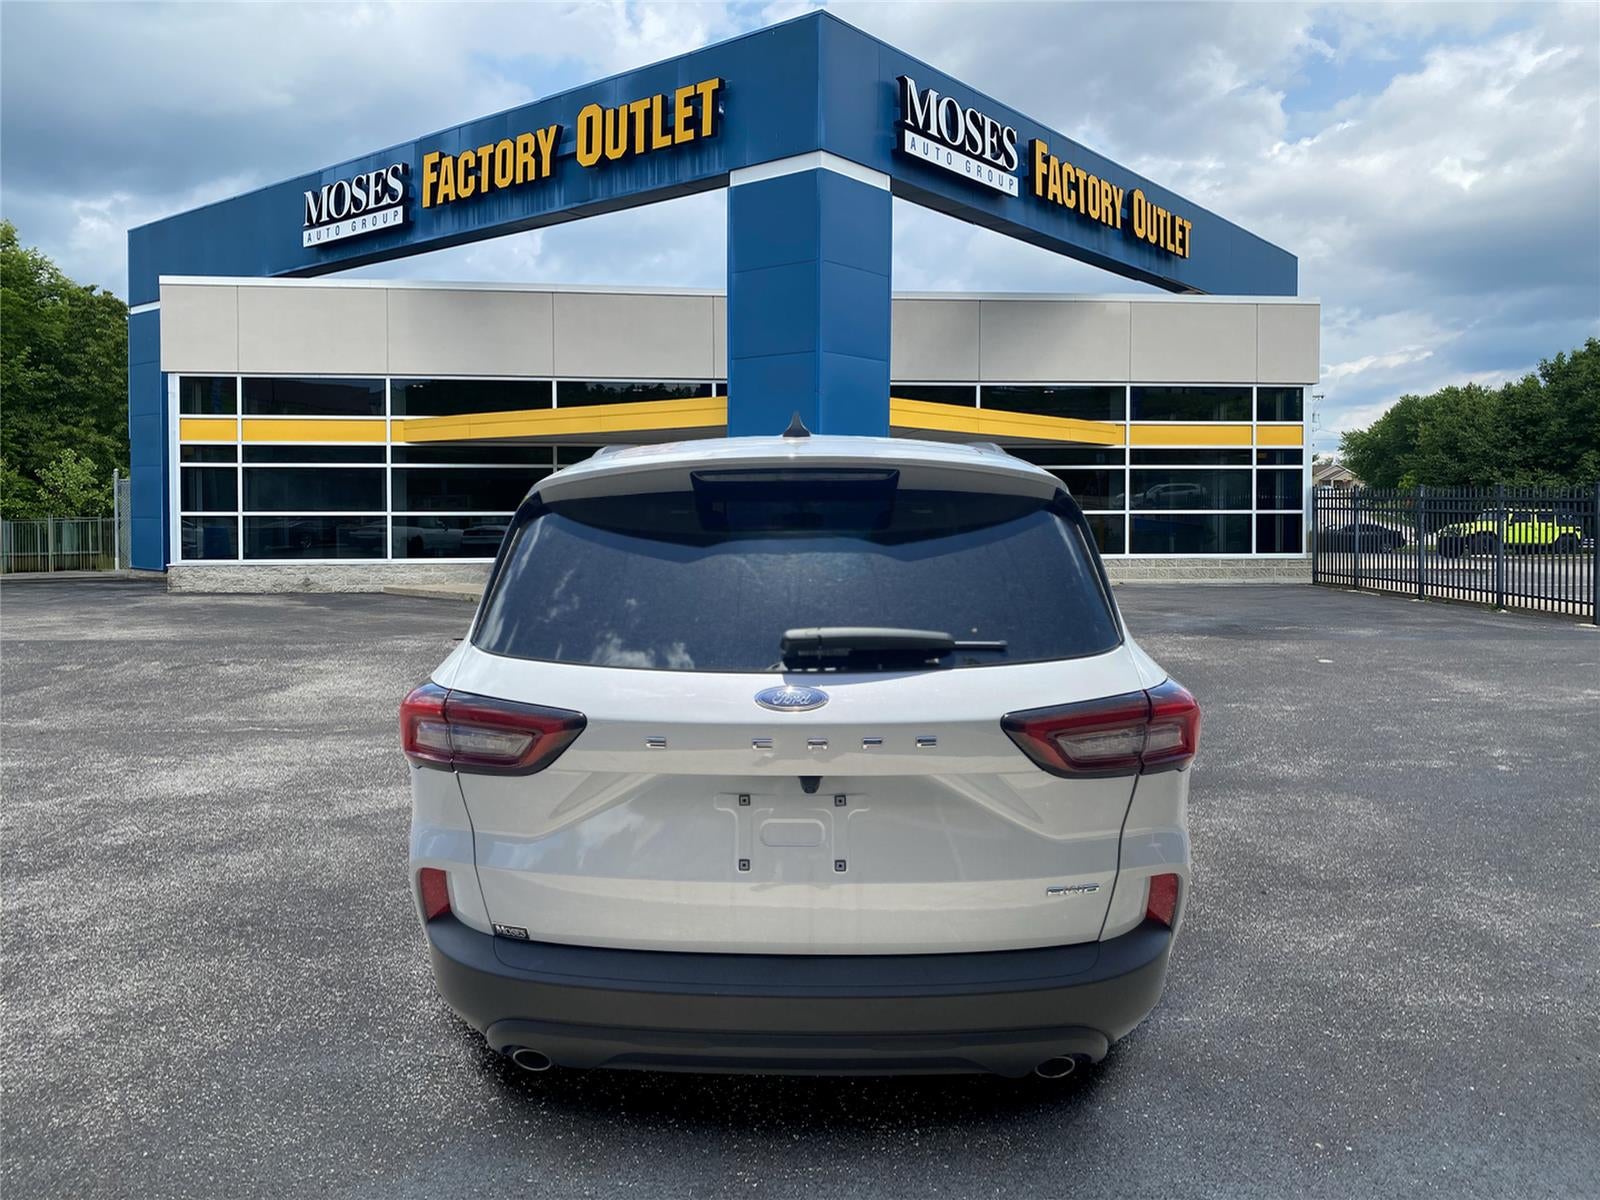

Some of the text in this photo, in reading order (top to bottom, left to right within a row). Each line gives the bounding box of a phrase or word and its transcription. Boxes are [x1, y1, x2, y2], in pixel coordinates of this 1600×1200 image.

[422, 77, 720, 208] FACTORY OUTLET
[904, 76, 1018, 172] MOSES
[303, 163, 404, 227] MOSES
[910, 136, 1015, 190] AUTO GROUP
[307, 210, 399, 243] AUTO GROUP
[1033, 138, 1193, 259] FACTORY OUTLET
[772, 690, 812, 705] Ford
